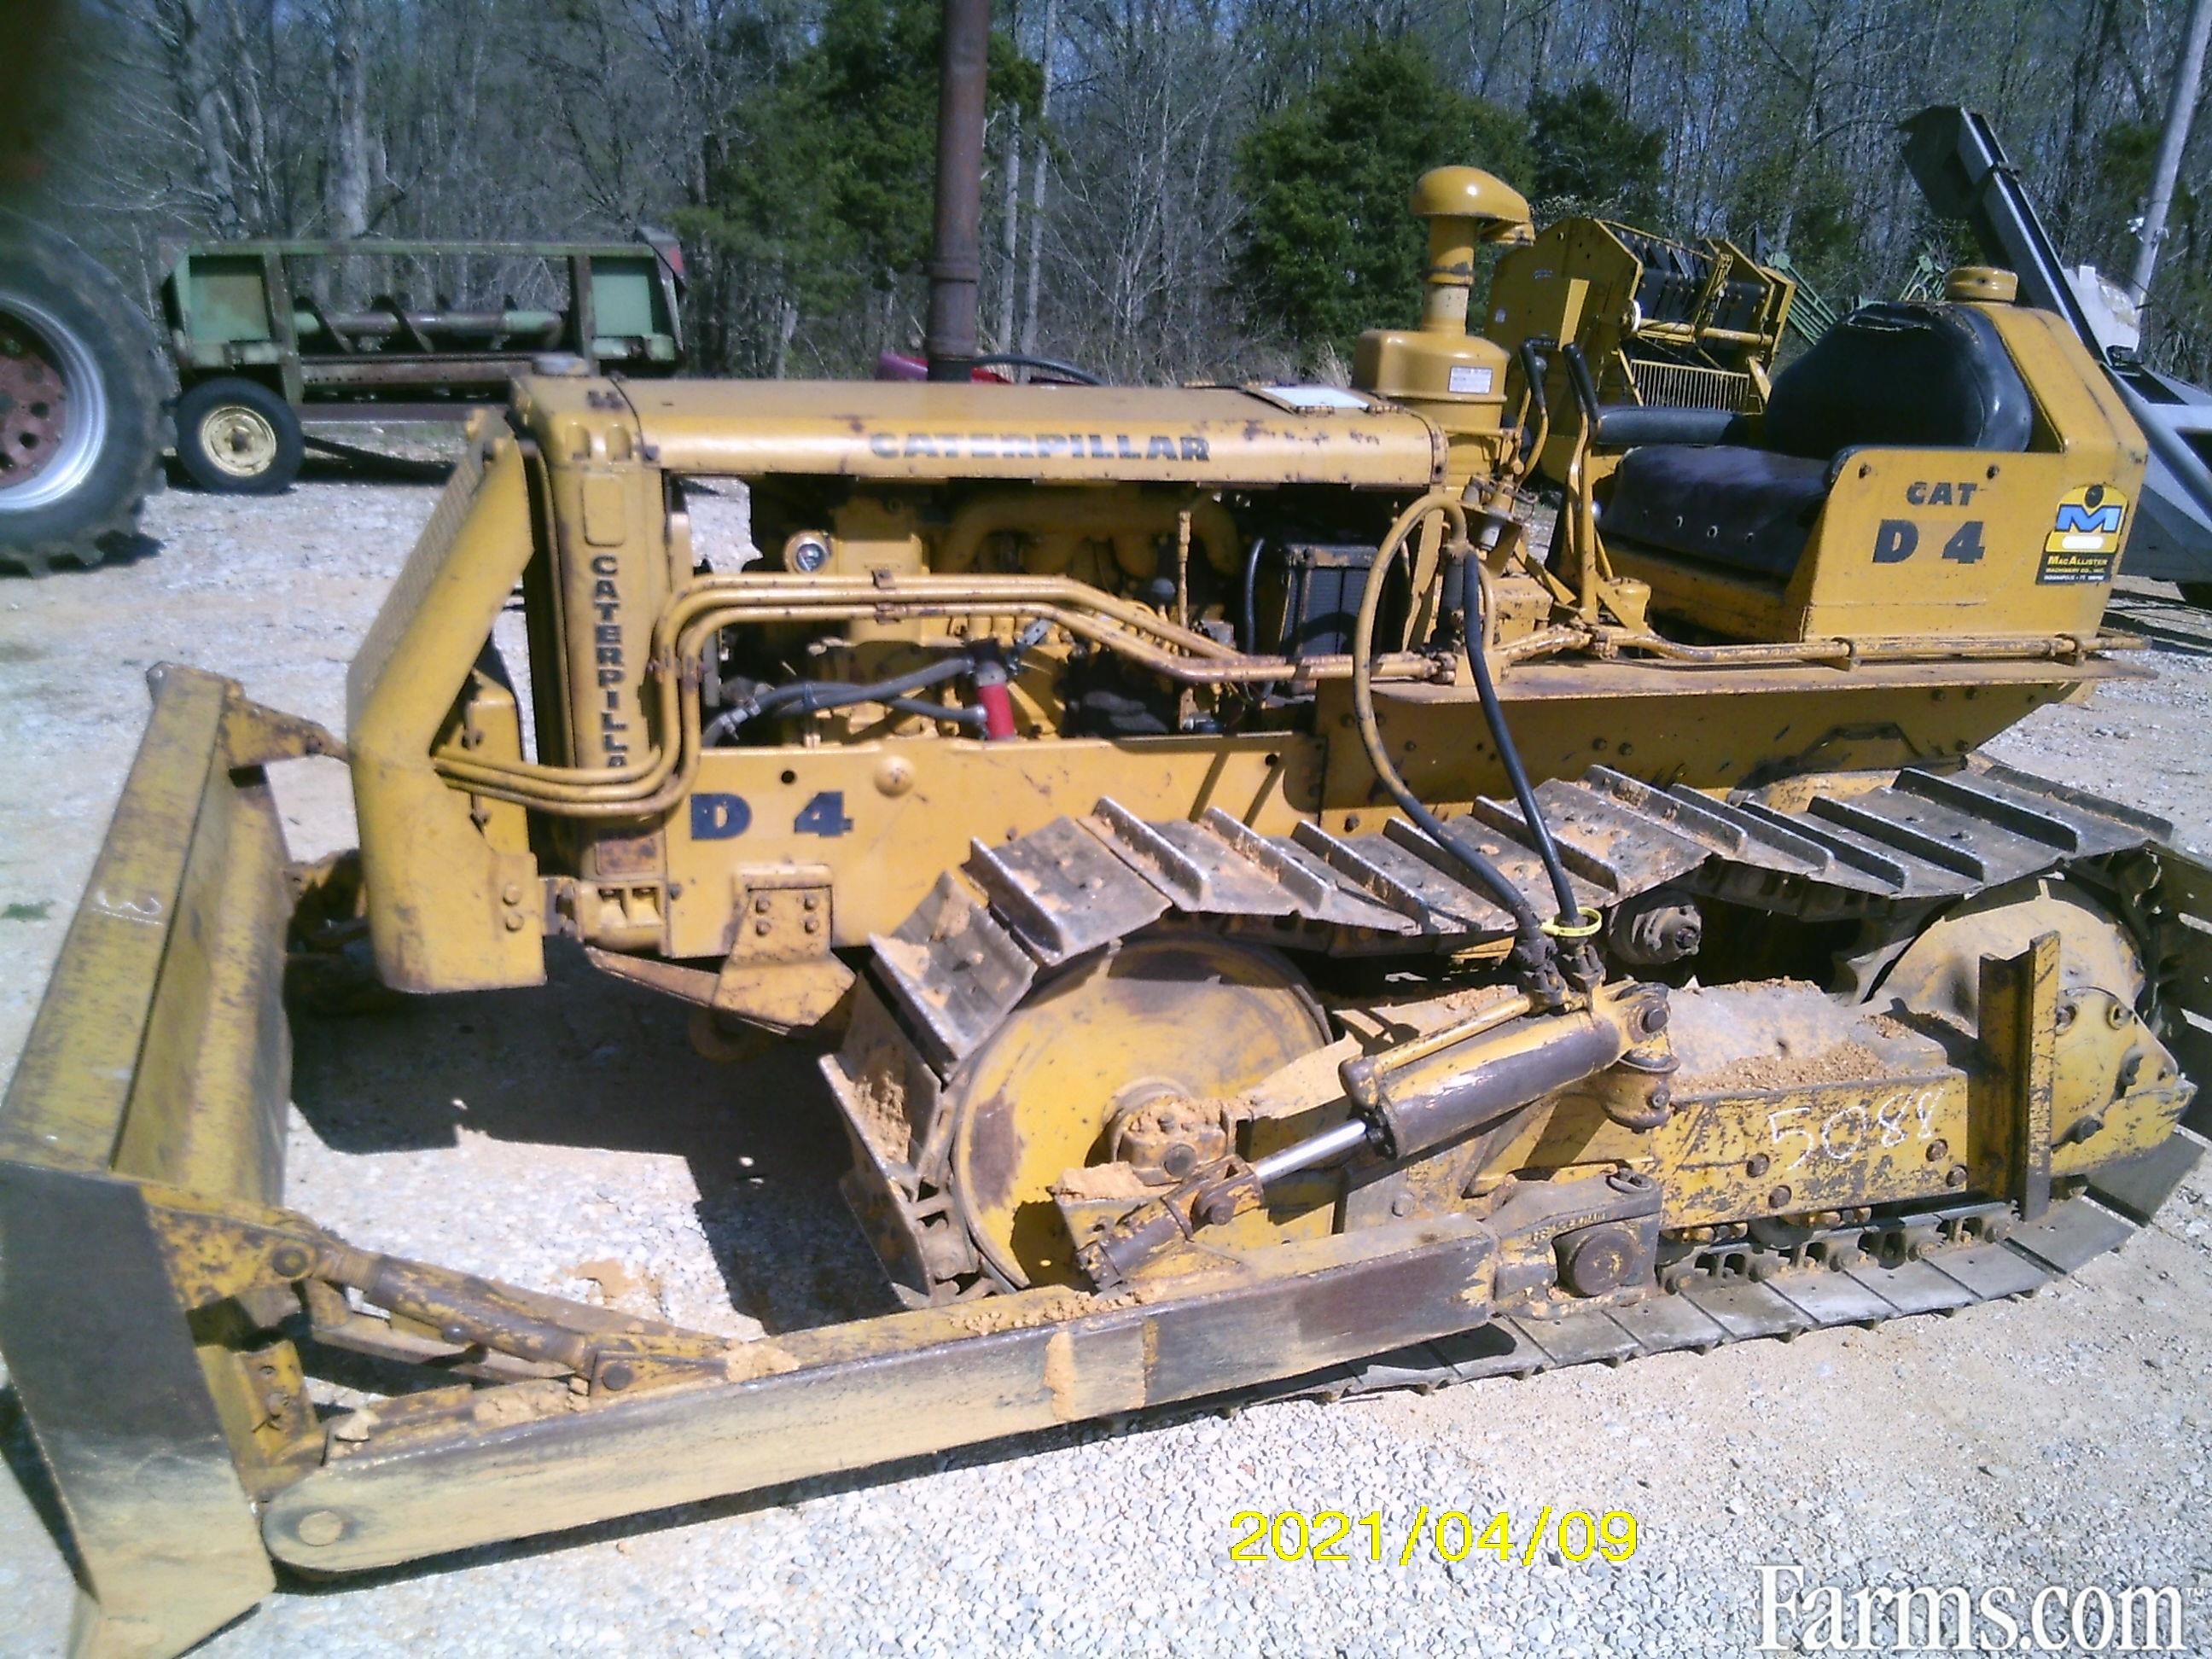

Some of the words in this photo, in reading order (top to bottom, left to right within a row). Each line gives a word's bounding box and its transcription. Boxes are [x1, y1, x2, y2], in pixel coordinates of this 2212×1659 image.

[869, 433, 1211, 462] CATERPILLAR
[1906, 480, 1978, 506] CAT
[1871, 518, 1919, 563] D
[1941, 521, 1987, 564] 4
[690, 792, 753, 841] D
[794, 790, 853, 837] 4
